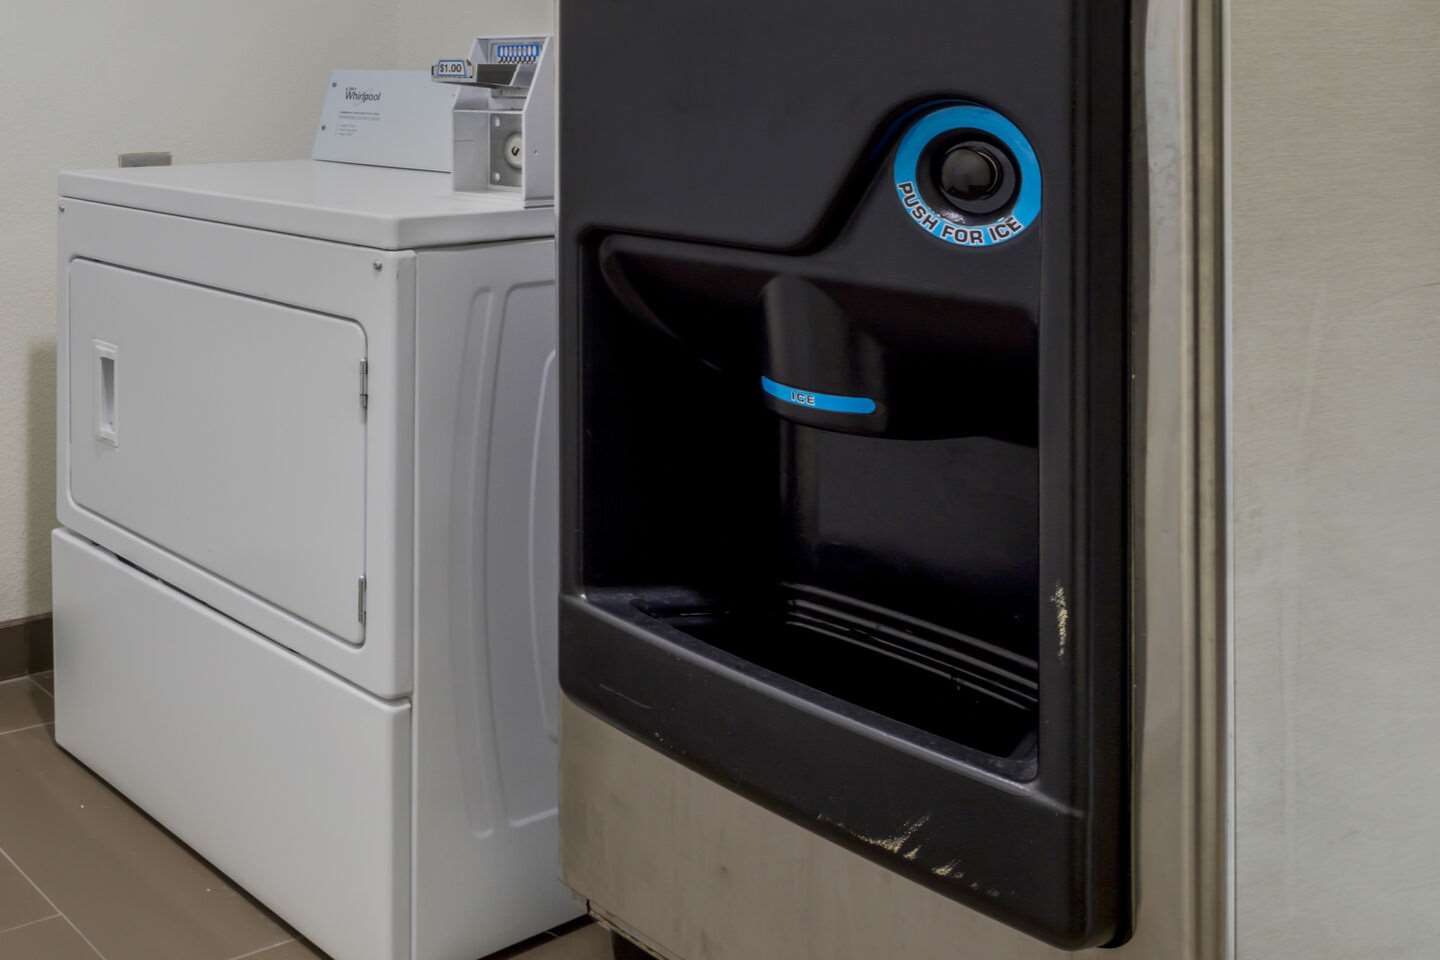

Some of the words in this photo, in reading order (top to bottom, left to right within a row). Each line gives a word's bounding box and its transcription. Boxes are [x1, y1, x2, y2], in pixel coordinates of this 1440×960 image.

[440, 63, 462, 73] $1.00
[345, 90, 382, 103] Whirlpool
[897, 181, 939, 231] PUSH
[941, 224, 984, 245] FOR
[988, 214, 1024, 241] ICE
[790, 391, 816, 407] ICE
